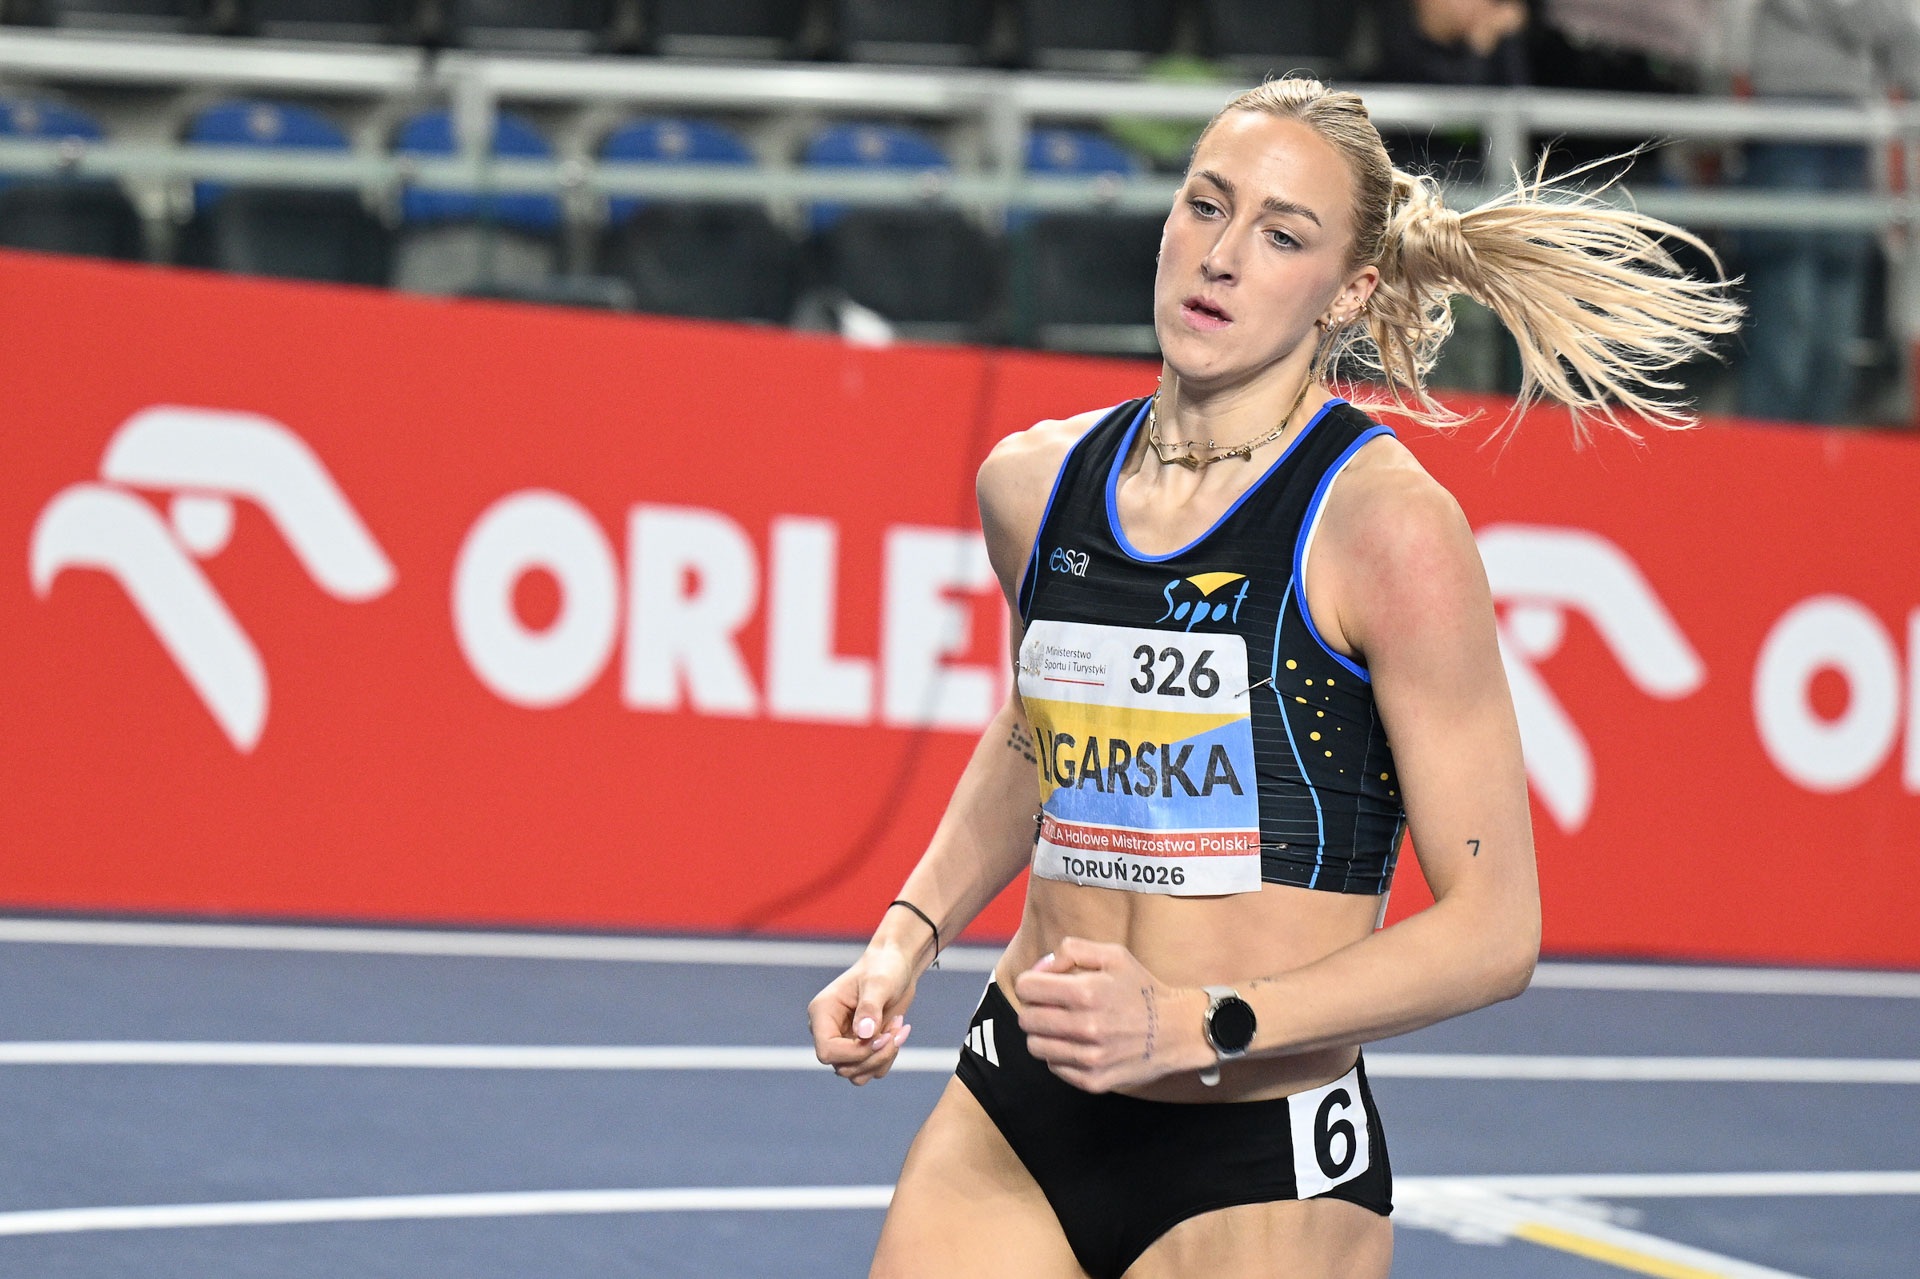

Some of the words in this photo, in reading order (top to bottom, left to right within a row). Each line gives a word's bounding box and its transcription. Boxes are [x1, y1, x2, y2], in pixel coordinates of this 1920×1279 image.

[452, 487, 1013, 731] ORLE
[1155, 579, 1250, 632] Sopot
[1044, 659, 1066, 672] Sportu
[1073, 661, 1106, 675] Turystyki
[1045, 645, 1092, 660] Ministerstwo
[1130, 644, 1220, 698] 326
[1751, 594, 1920, 795] O
[1035, 726, 1244, 798] LIGARSKA
[1065, 829, 1109, 847] Halowe
[1112, 834, 1196, 853] Mistrzostwa
[1201, 836, 1248, 852] Polski
[1063, 856, 1127, 881] TORUŃ
[1132, 865, 1185, 886] 2026
[1314, 1087, 1357, 1180] 6
